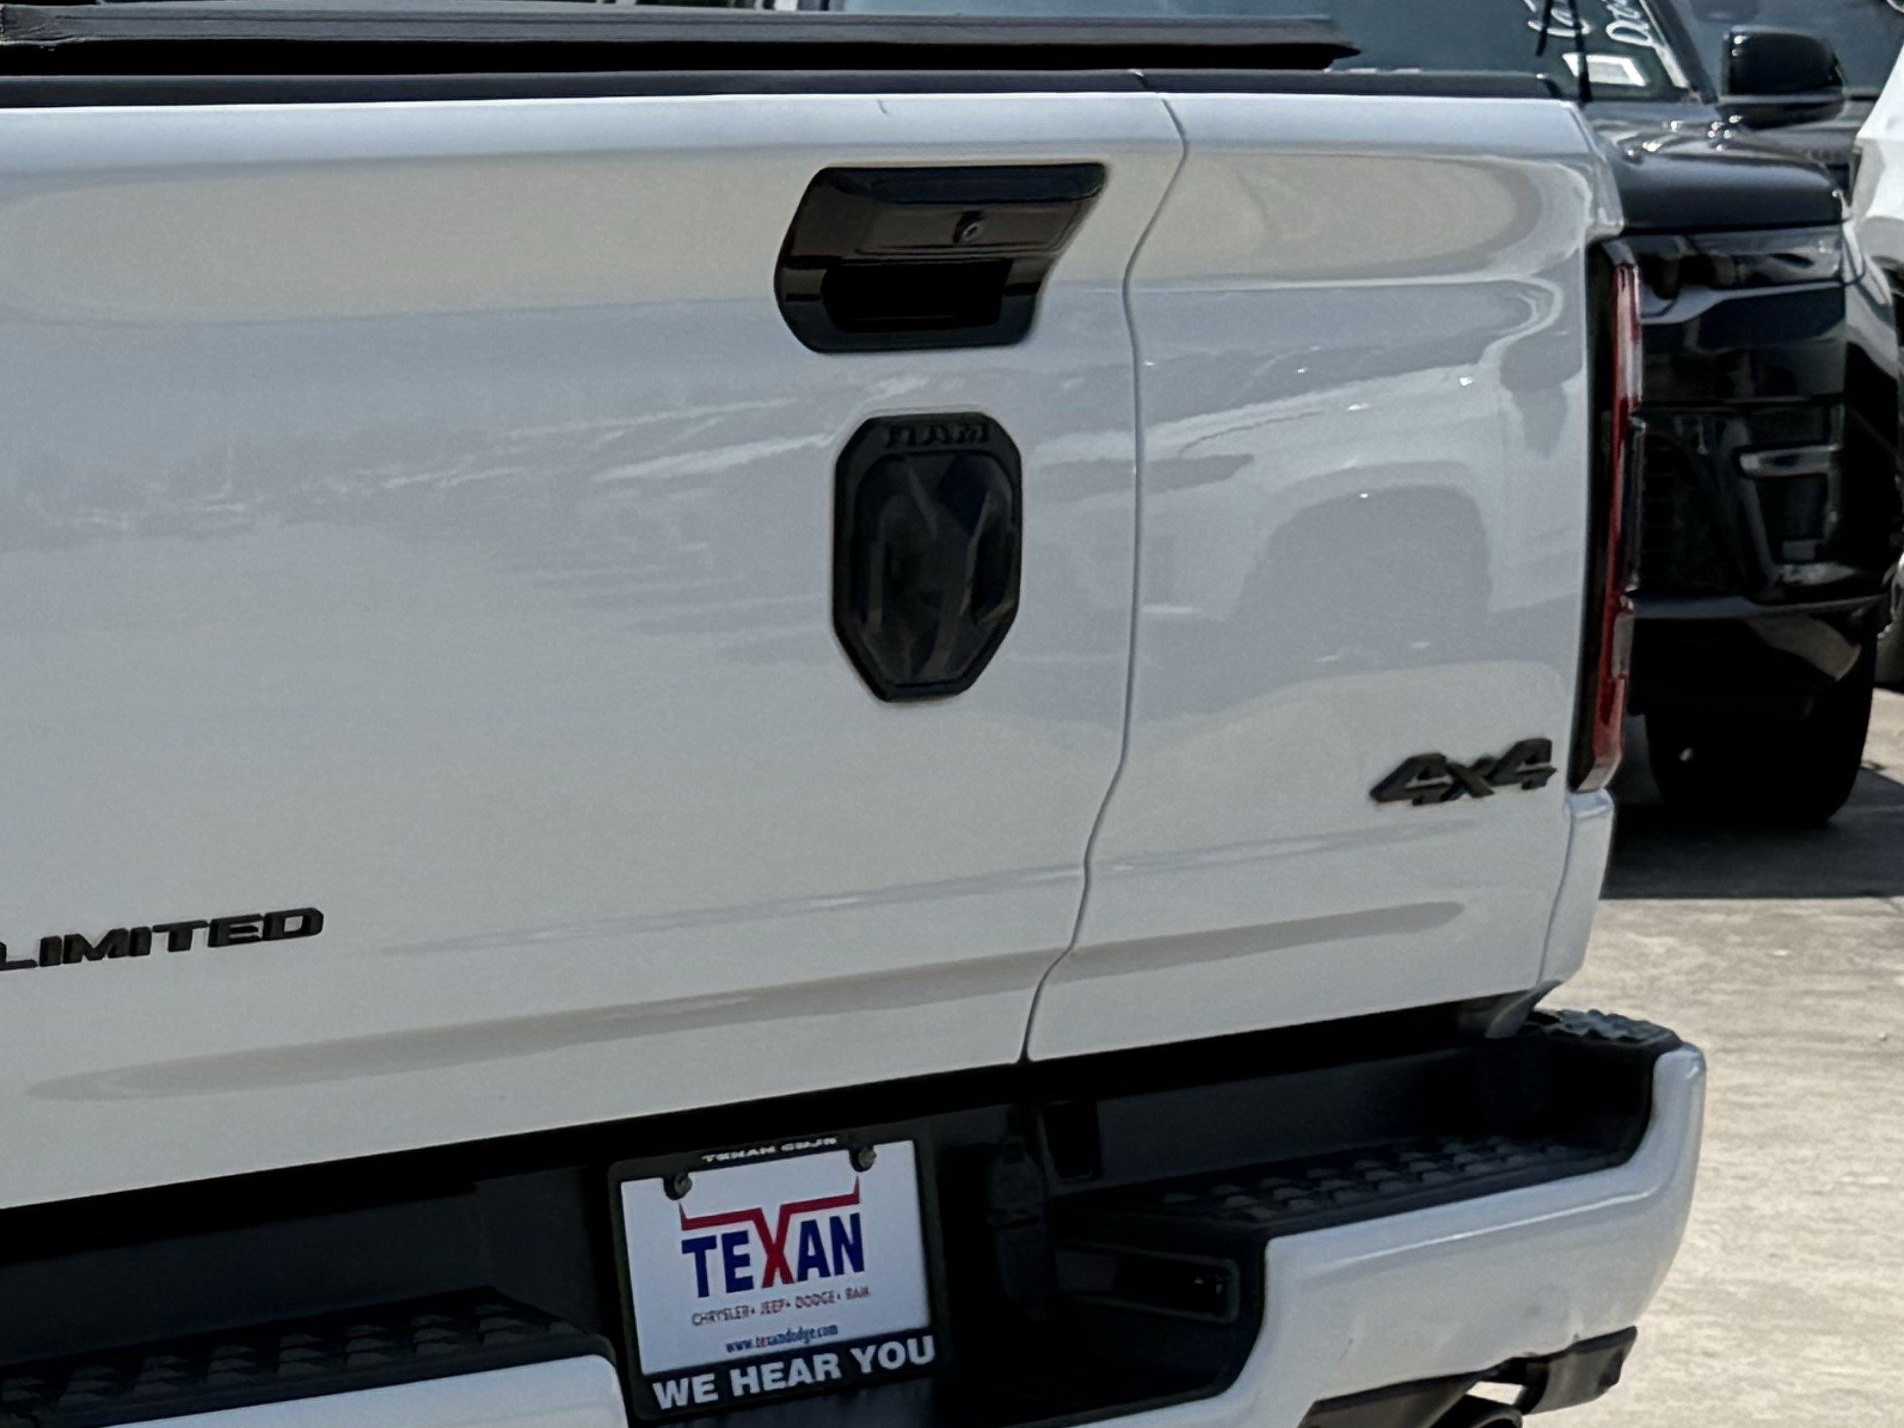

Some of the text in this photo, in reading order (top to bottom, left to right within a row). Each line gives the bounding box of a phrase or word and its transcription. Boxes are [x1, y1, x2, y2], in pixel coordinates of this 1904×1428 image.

[701, 1145, 777, 1163] TEXAN
[681, 1200, 865, 1299] TEXAN
[691, 1286, 870, 1327] CHRYSLER JEEP DODGE RAM
[725, 1323, 839, 1354] www.texandodge.com
[652, 1334, 936, 1410] WE HEAR YOU
